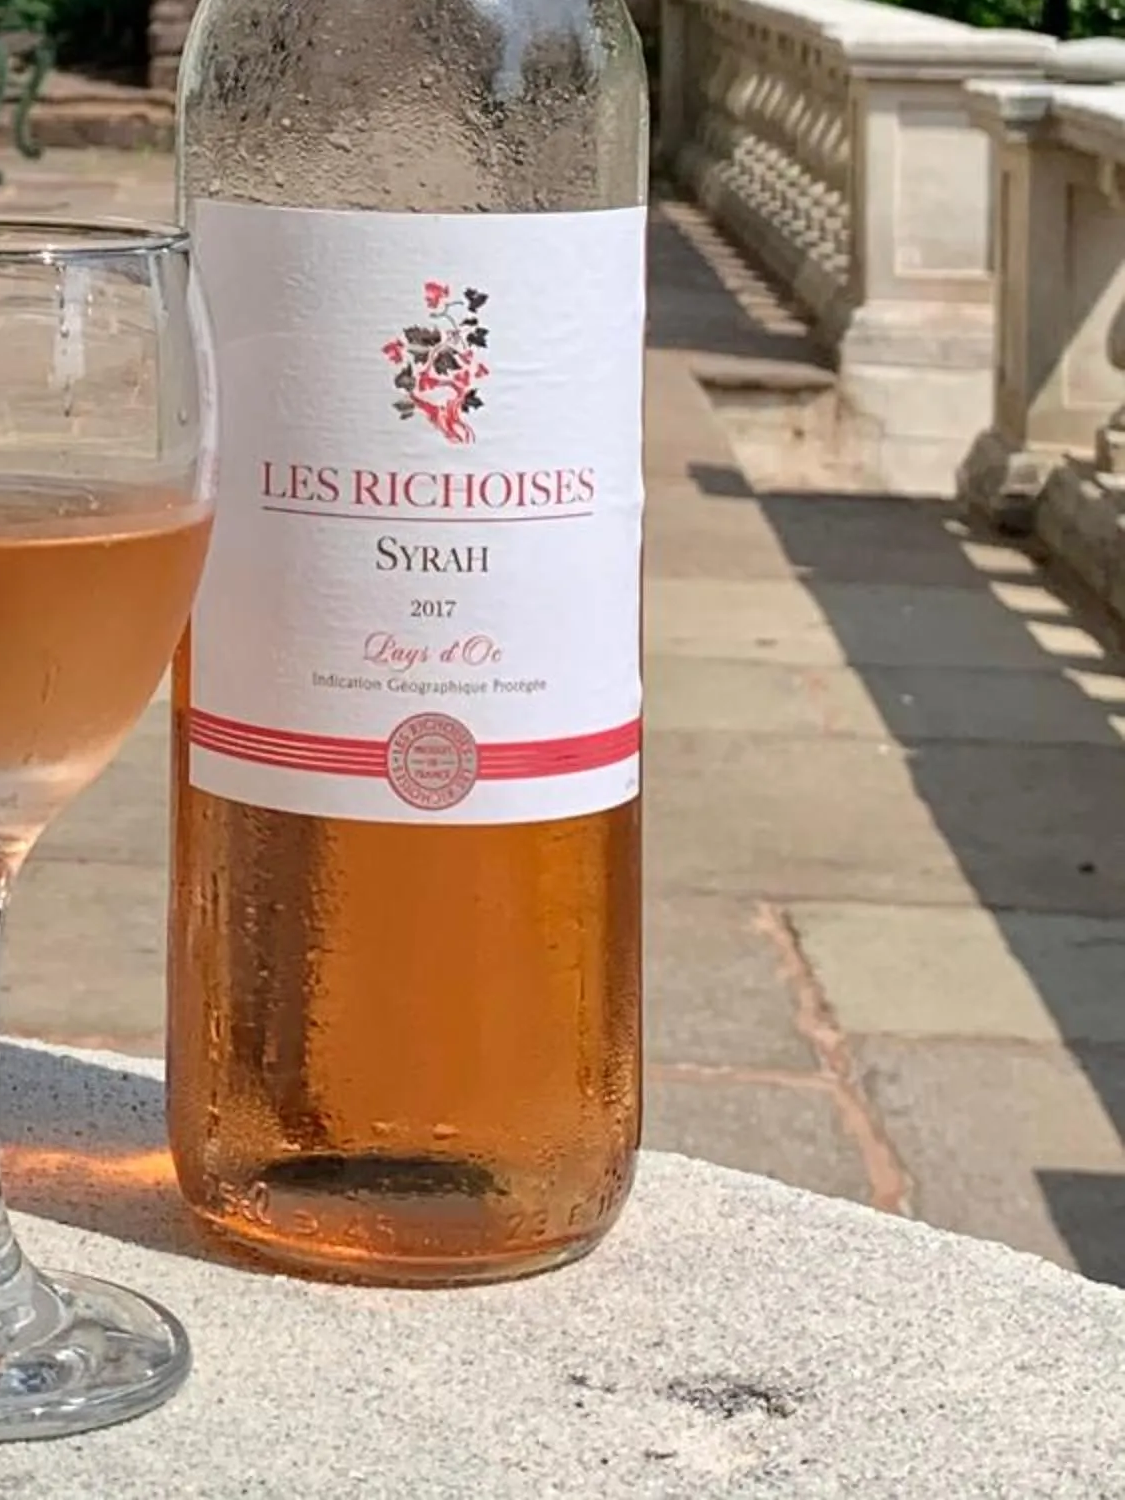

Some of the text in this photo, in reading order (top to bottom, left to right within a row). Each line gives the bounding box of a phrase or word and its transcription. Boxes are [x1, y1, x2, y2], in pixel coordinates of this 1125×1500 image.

[261, 461, 596, 508] LES RICHOISES
[376, 535, 489, 573] SYRAH
[410, 599, 457, 618] 2017
[363, 630, 504, 672] Pays d'Oc
[312, 671, 382, 690] Indication
